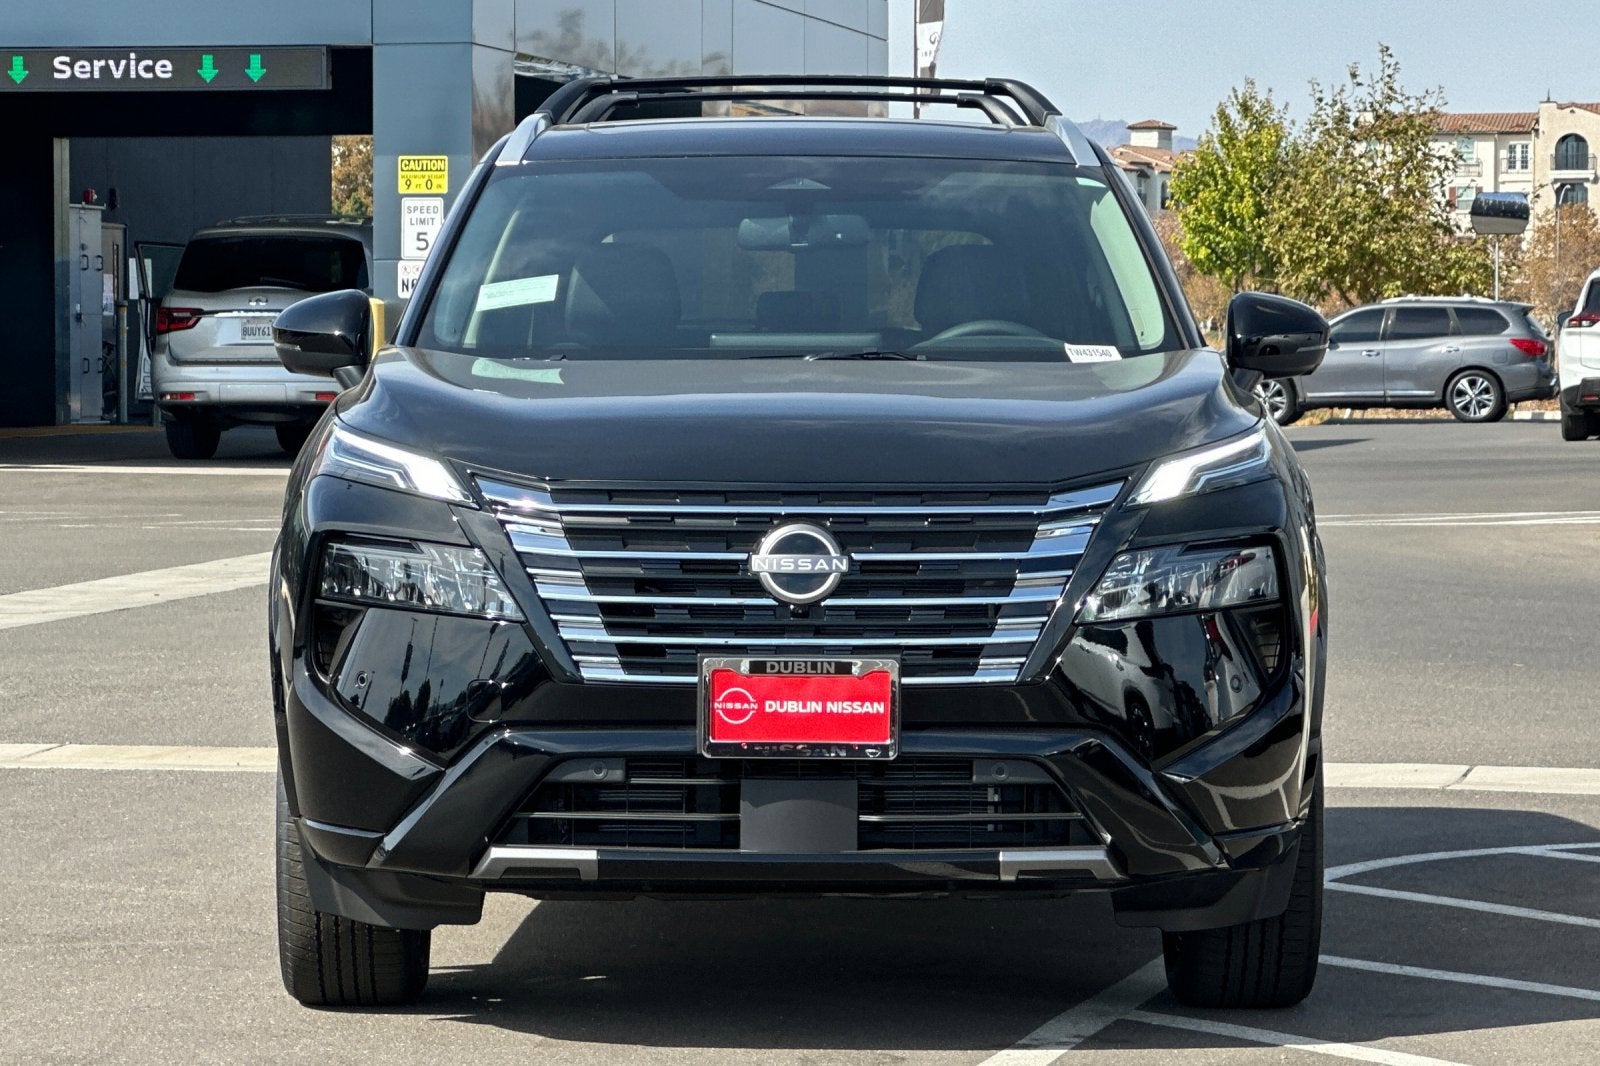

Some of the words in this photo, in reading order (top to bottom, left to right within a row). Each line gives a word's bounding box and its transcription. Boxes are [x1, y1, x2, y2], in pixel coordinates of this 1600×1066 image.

[53, 52, 173, 79] Service
[401, 159, 445, 171] CAUTION
[405, 178, 412, 190] 9
[406, 205, 439, 215] SPEED
[409, 217, 436, 226] LIMIT
[415, 232, 429, 251] 5
[754, 558, 848, 571] NISSAN
[765, 661, 836, 674] DUBLIN
[714, 702, 758, 710] NISSAN
[765, 700, 823, 713] DUBLIN
[826, 701, 885, 714] NISSAN
